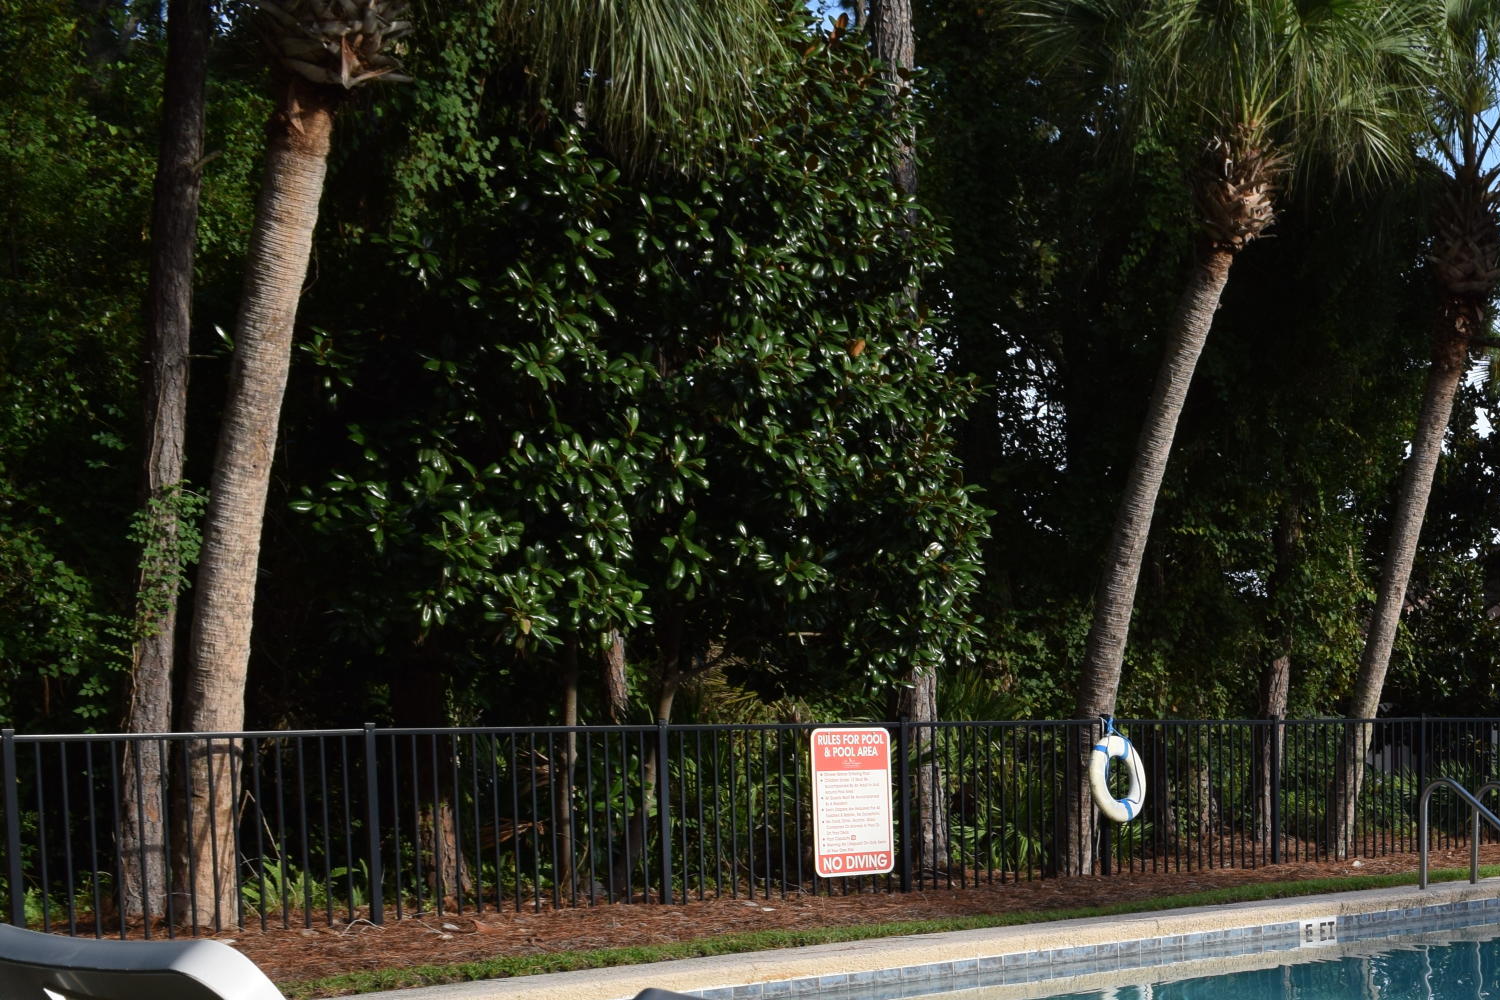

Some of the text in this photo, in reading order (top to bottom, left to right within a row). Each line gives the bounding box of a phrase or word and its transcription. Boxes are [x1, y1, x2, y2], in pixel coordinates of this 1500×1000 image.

[817, 734, 884, 745] RULES FOR POOL
[824, 746, 878, 757] & POOL AREA
[823, 853, 888, 872] NO DIVING
